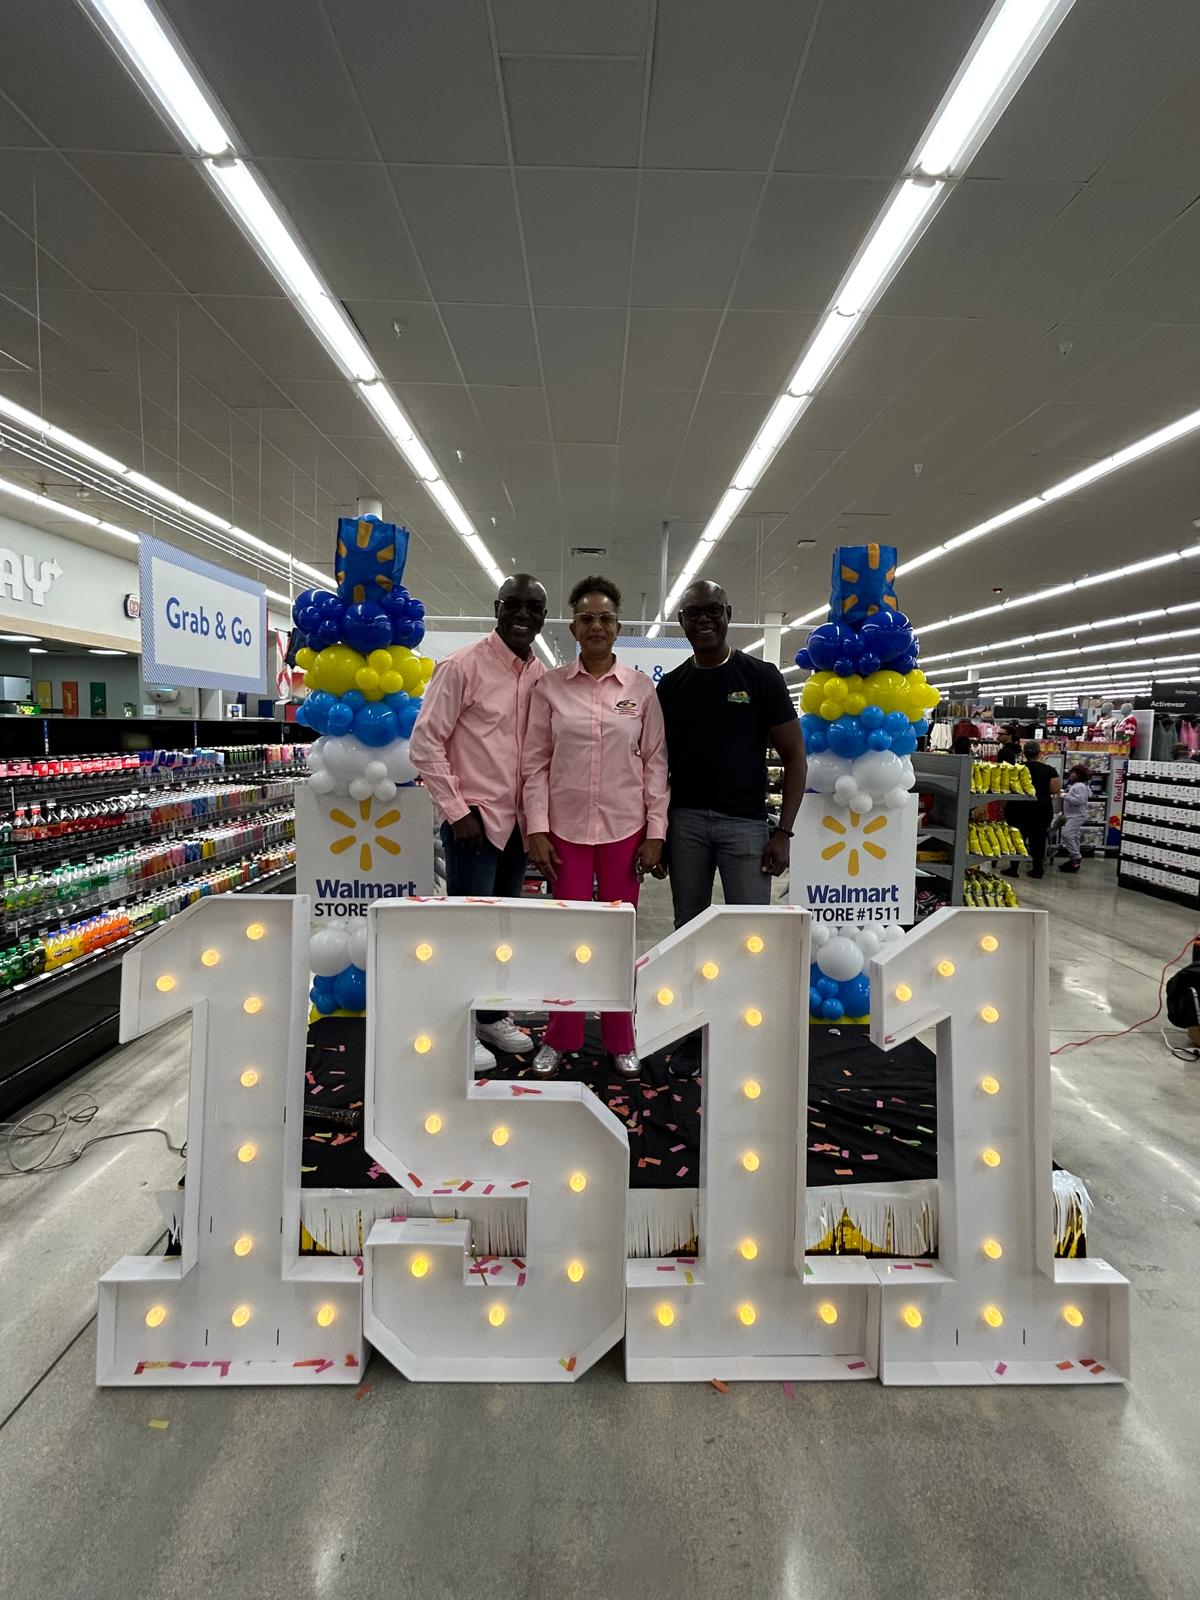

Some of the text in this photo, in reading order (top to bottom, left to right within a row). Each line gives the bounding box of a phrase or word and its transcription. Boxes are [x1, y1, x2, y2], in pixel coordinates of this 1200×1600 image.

[166, 596, 209, 637] Grab
[215, 611, 226, 641] &
[231, 617, 252, 646] Go
[1150, 700, 1186, 708] Activewear
[1113, 768, 1125, 803] Red Bull
[316, 879, 417, 899] Walmart
[806, 884, 899, 904] Walmart
[314, 902, 368, 917] STORE
[856, 906, 900, 921] #1511
